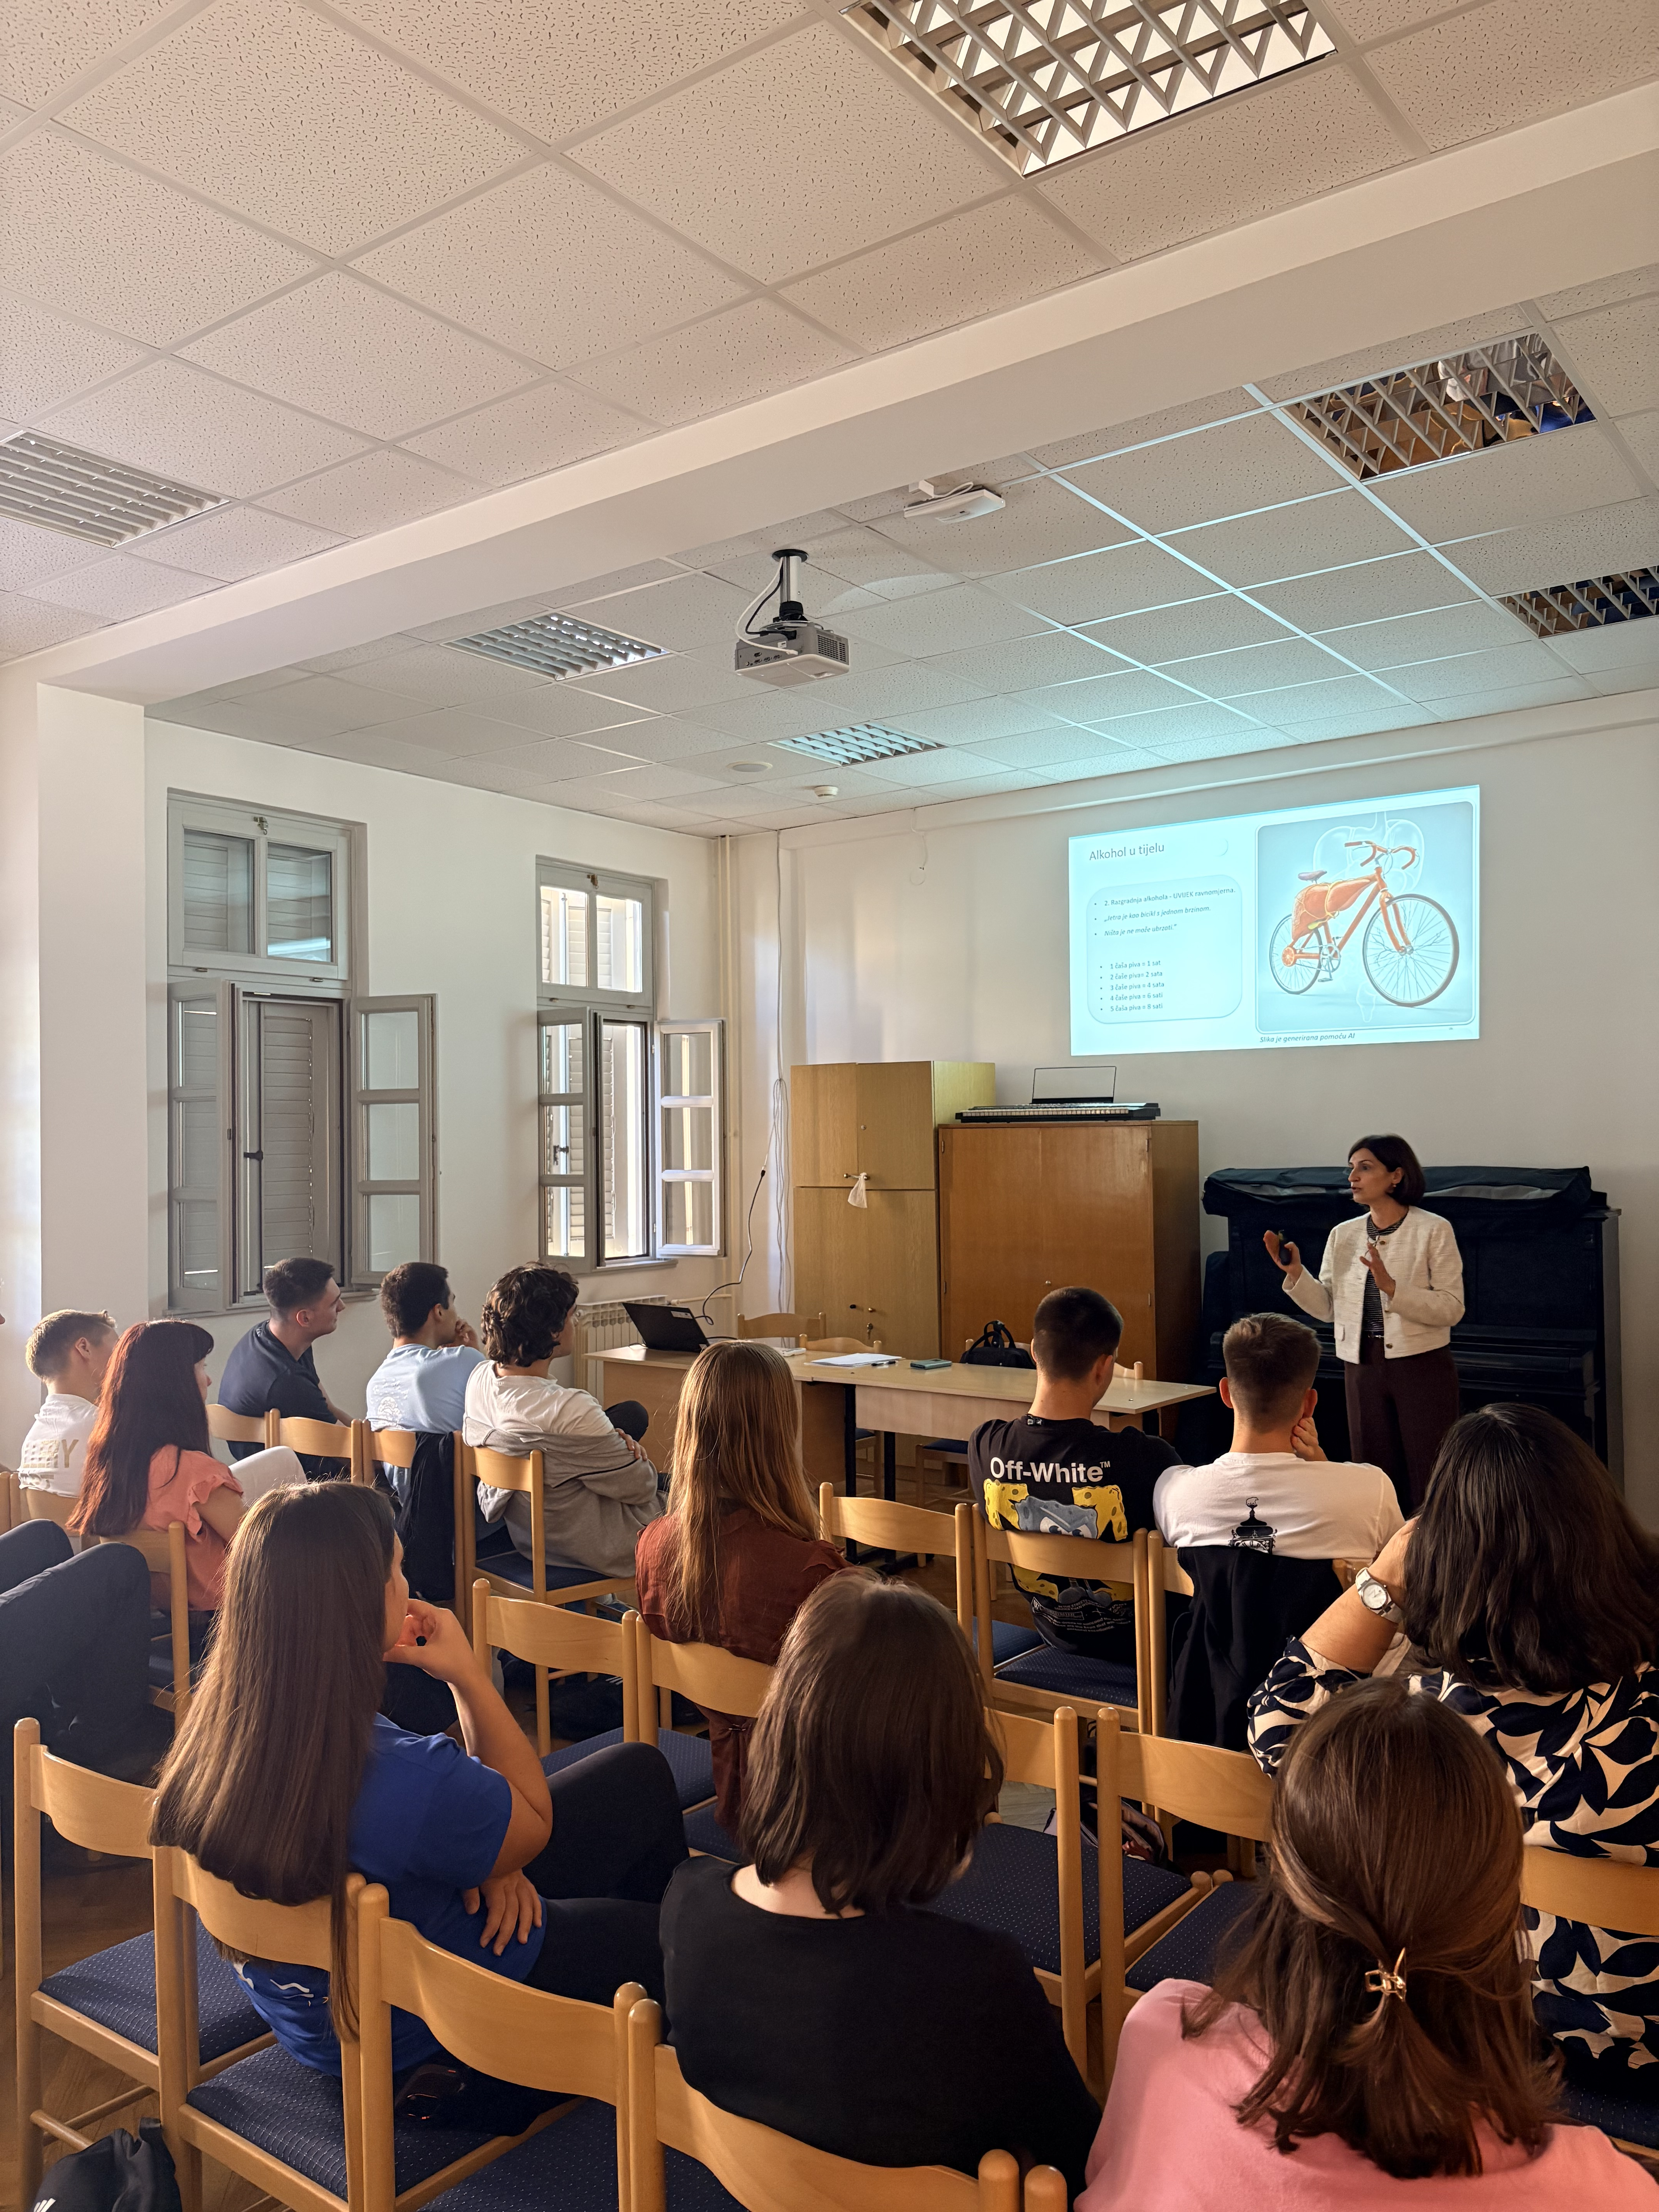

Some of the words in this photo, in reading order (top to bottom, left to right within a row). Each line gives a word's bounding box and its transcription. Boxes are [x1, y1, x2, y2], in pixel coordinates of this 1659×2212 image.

[1089, 847, 1126, 861] Alkohol
[1139, 842, 1164, 856] tijelu
[1195, 888, 1235, 896] ravnomjerna.
[1161, 909, 1183, 917] jednom
[1283, 1035, 1319, 1043] generirana
[1319, 1033, 1346, 1041] pomoću
